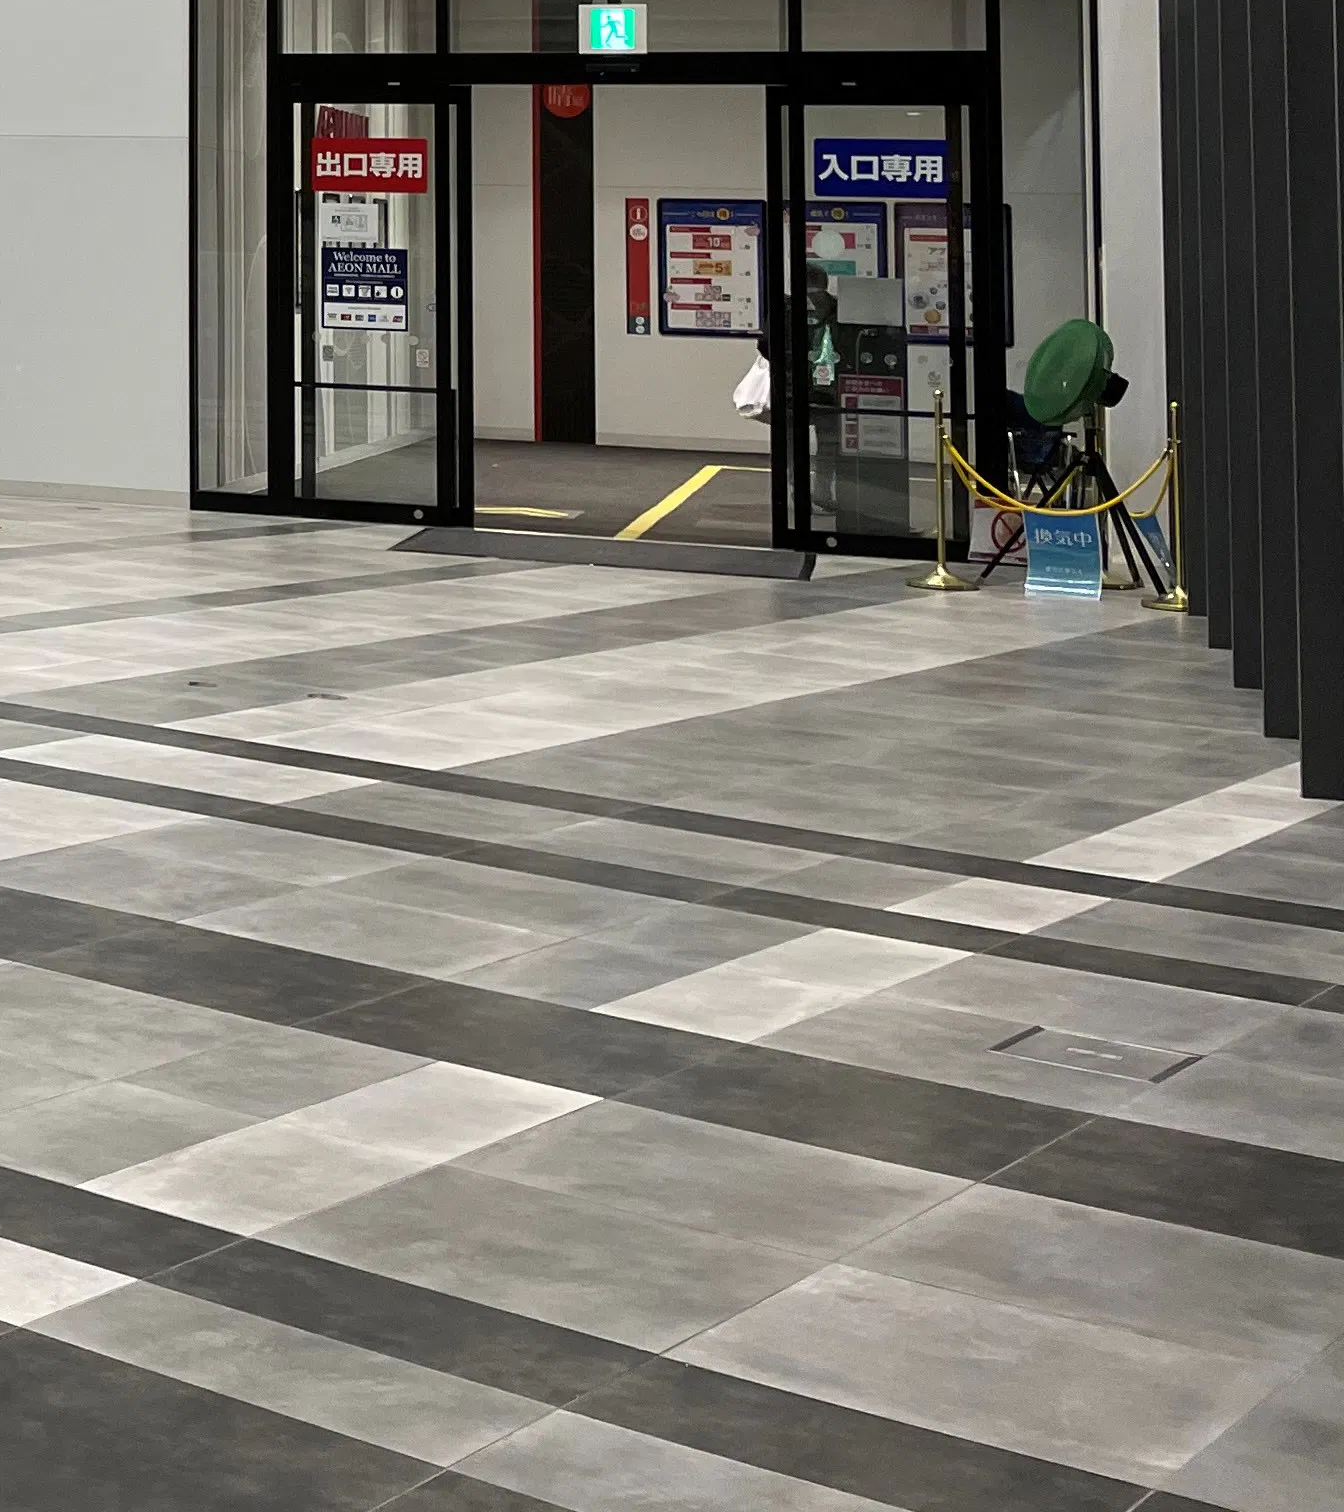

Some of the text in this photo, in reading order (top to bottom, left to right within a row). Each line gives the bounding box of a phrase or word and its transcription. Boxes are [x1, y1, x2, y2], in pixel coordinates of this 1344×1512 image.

[316, 151, 423, 179] 出口専用
[818, 153, 944, 183] 入口専用
[332, 251, 397, 264] Welcome to
[328, 262, 363, 274] AEON
[365, 263, 402, 276] MALL
[1033, 527, 1093, 548] 換気中
